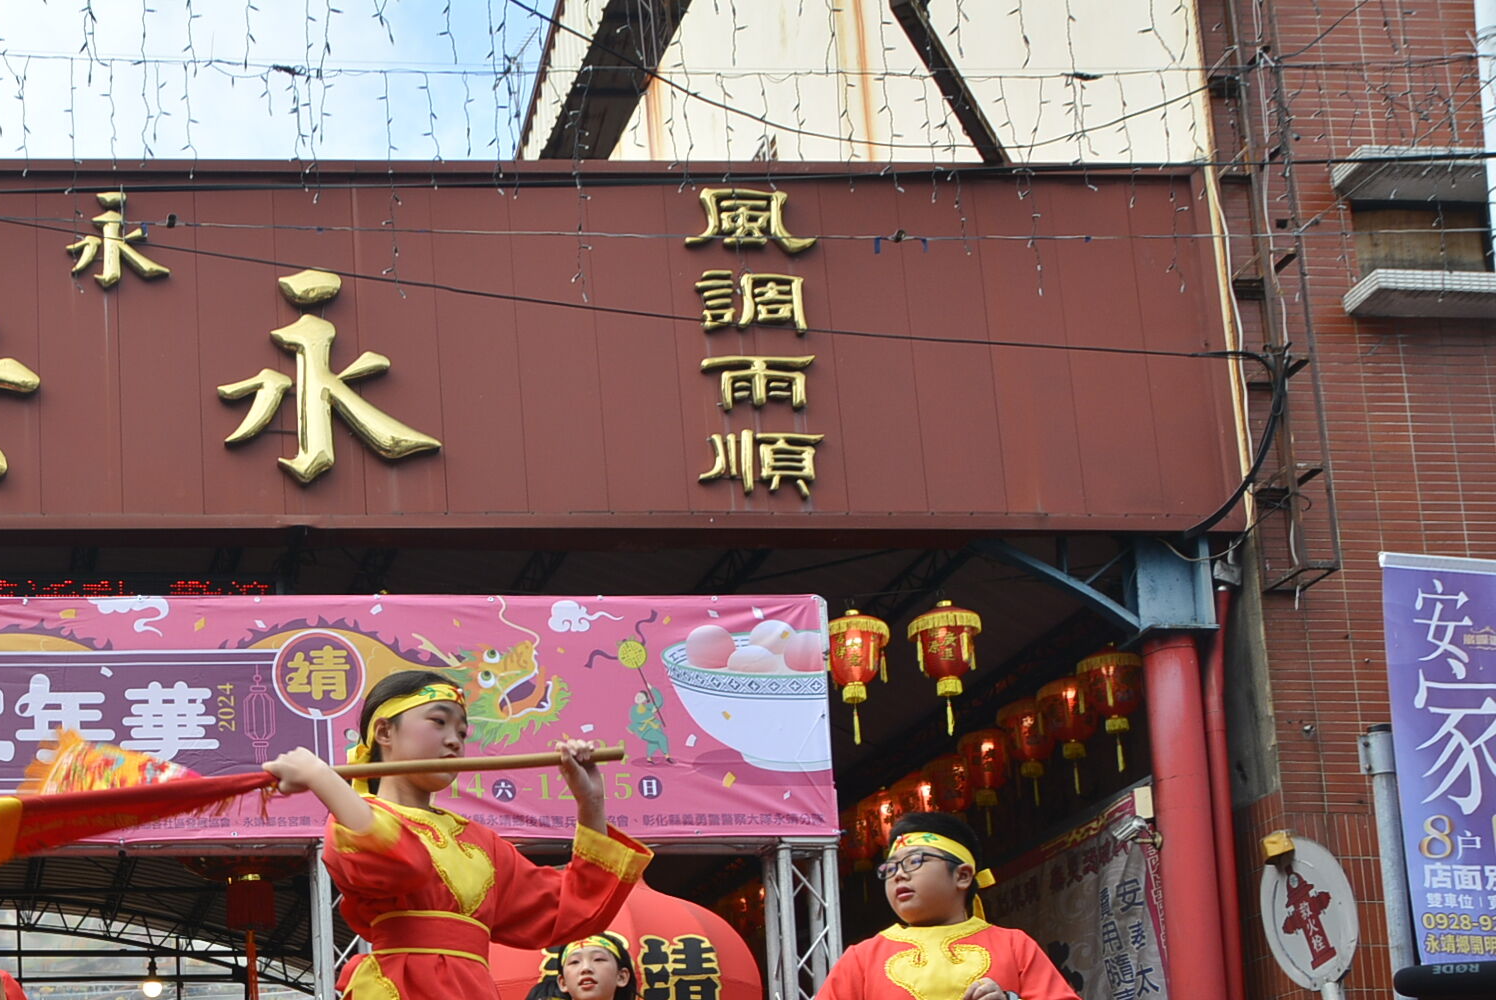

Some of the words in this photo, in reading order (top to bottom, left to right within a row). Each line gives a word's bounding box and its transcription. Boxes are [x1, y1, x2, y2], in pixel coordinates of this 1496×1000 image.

[684, 187, 825, 499] 風調雨順
[285, 645, 351, 701] 靖
[218, 682, 236, 732] 2024
[494, 781, 513, 799] 六
[642, 779, 657, 797] 日
